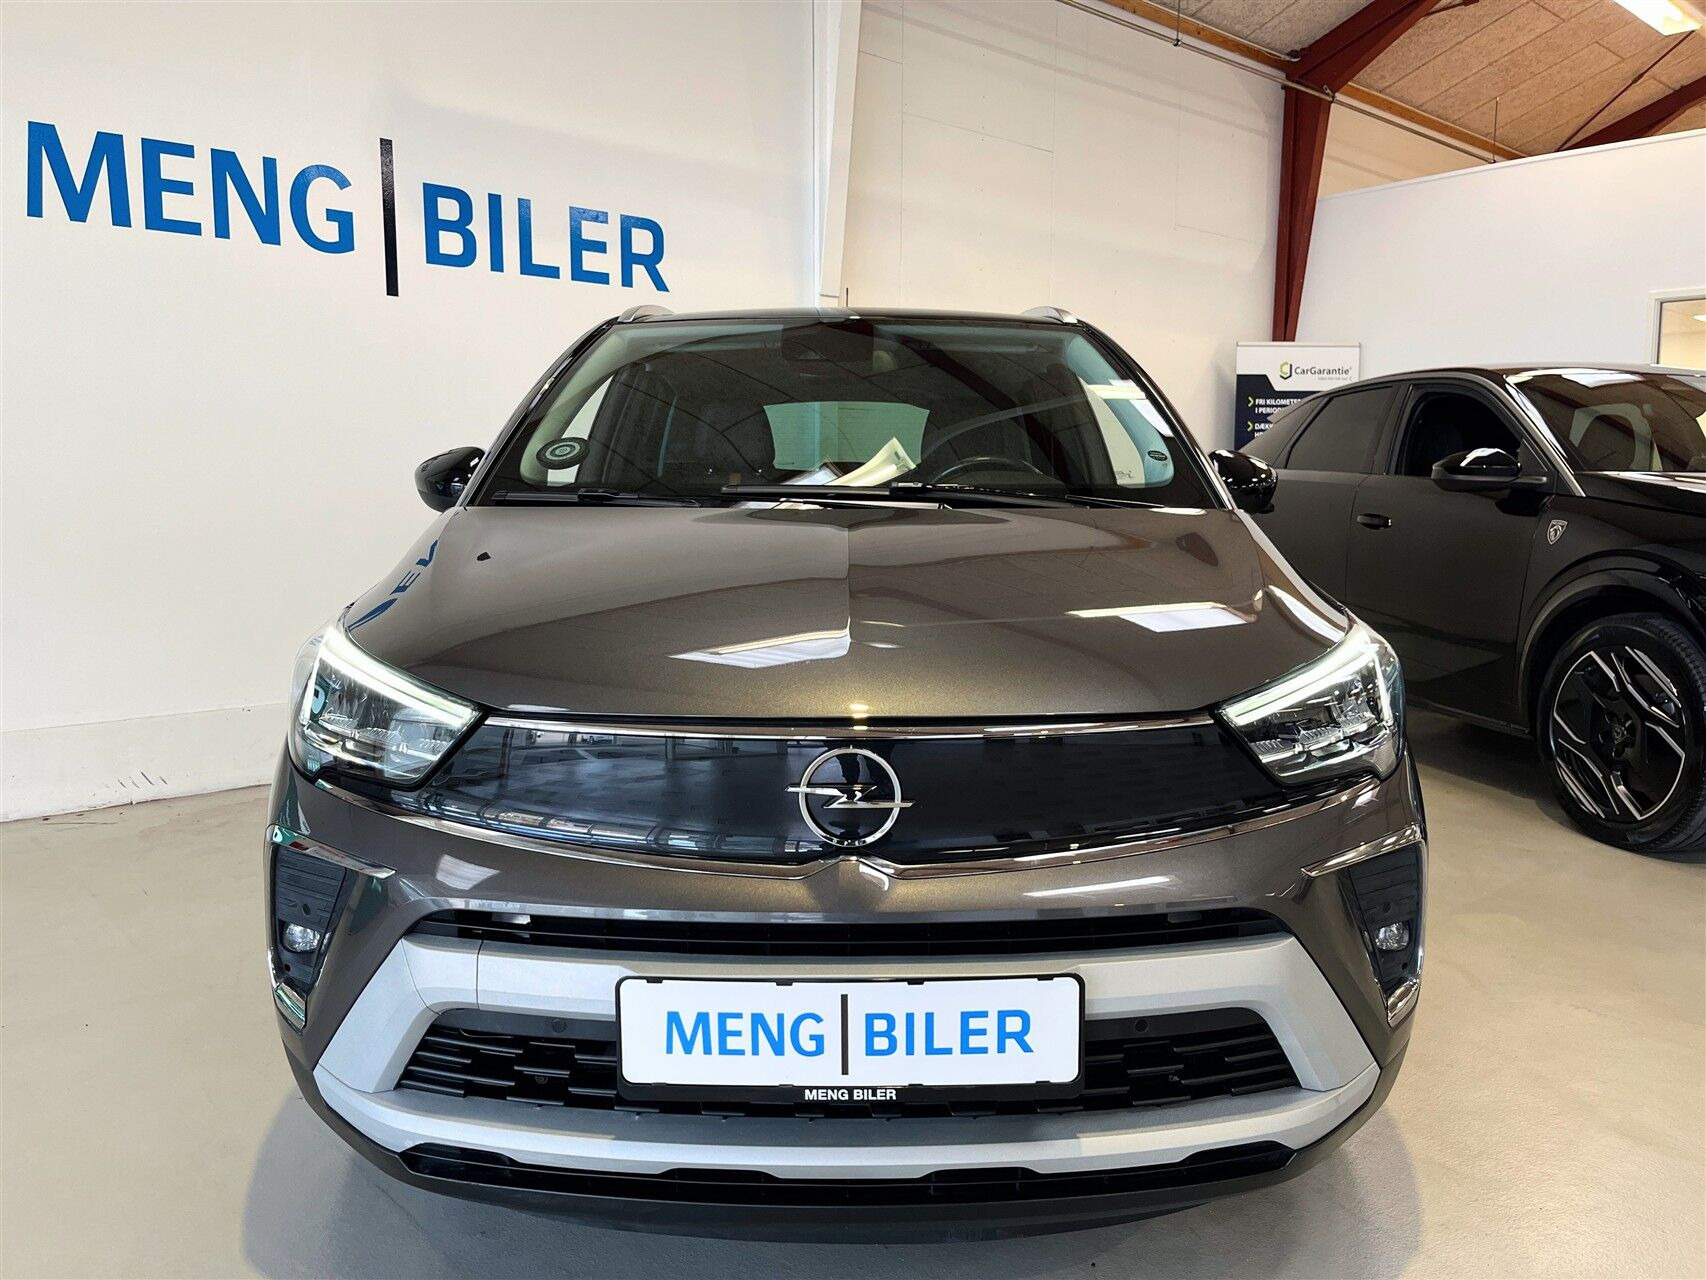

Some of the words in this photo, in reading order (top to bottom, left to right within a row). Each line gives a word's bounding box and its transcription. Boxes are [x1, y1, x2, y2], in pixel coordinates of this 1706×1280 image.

[27, 121, 355, 254] MENG
[422, 182, 670, 292] BILER
[1294, 366, 1350, 375] CarGarantie
[666, 1011, 825, 1057] MENG
[865, 1010, 1034, 1056] BILER
[804, 1089, 849, 1100] MENG
[853, 1089, 896, 1100] BILER
